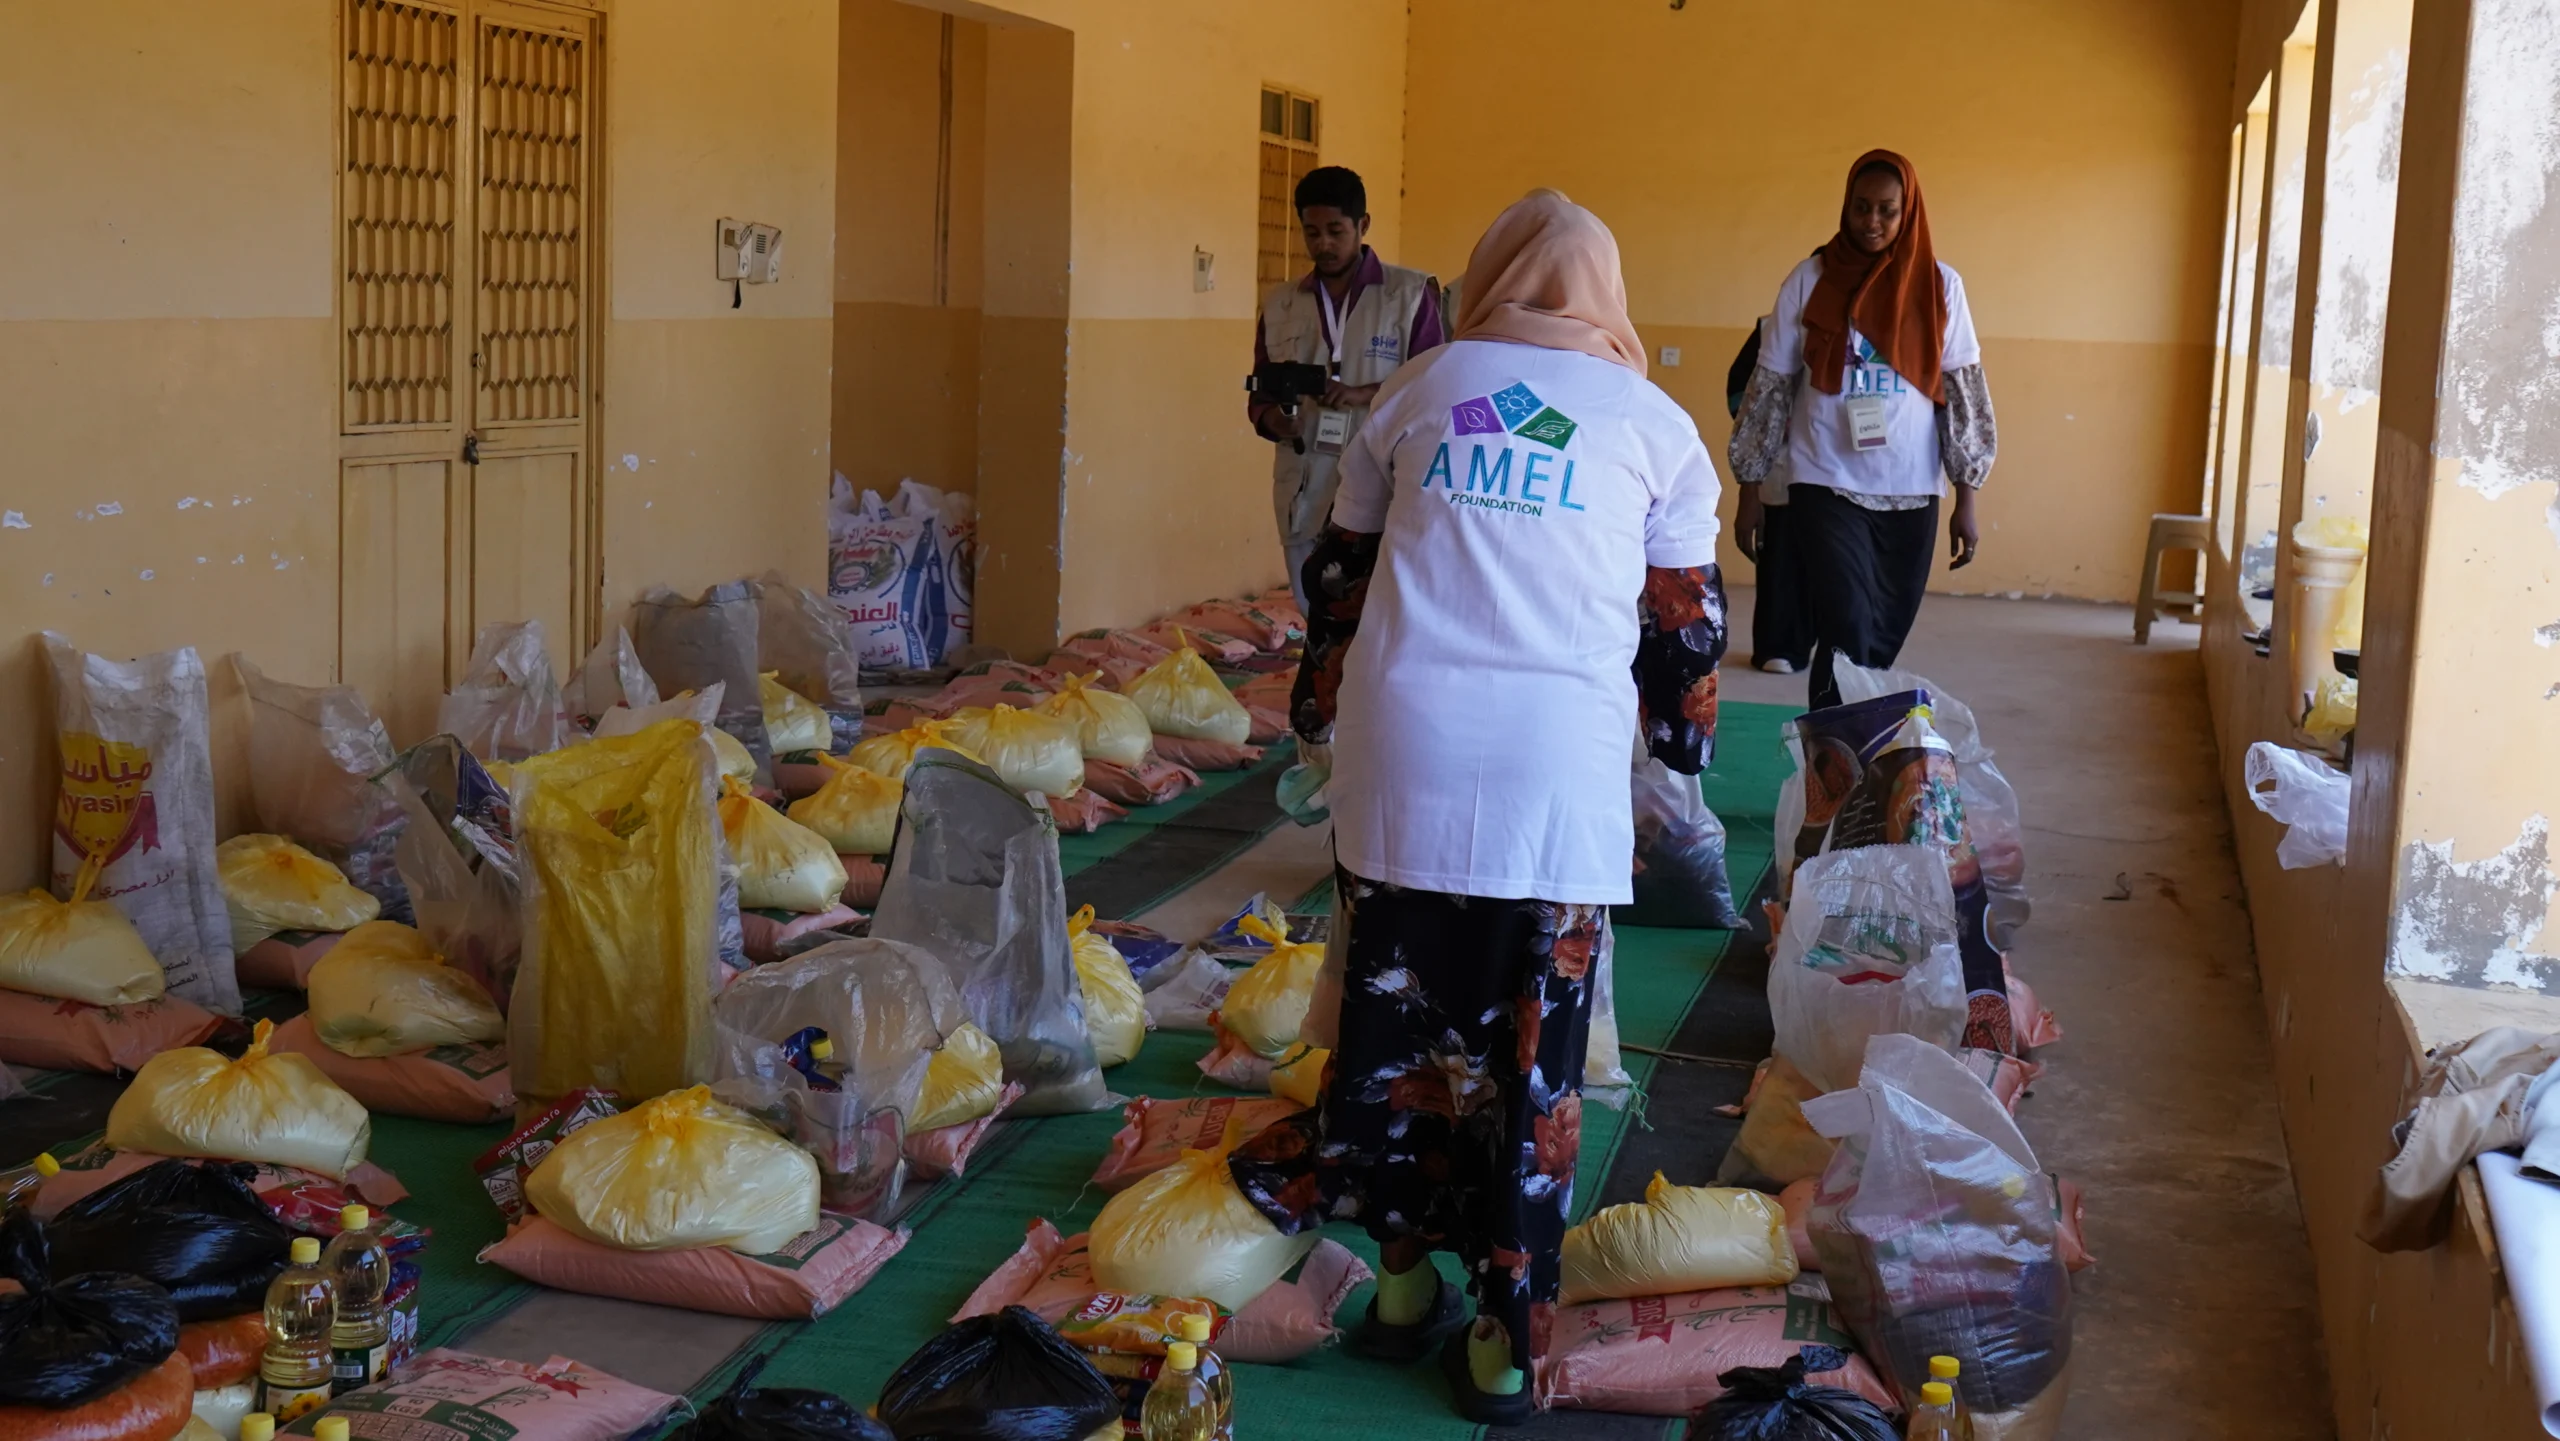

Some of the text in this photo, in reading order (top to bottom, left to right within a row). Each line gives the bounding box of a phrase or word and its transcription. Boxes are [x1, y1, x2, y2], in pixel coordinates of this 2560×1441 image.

[1841, 369, 1907, 393] MEL
[1421, 442, 1585, 512] AMEL
[1450, 493, 1543, 517] FOUNDATION
[529, 1115, 551, 1134] كيس
[388, 1403, 422, 1415] KGS
